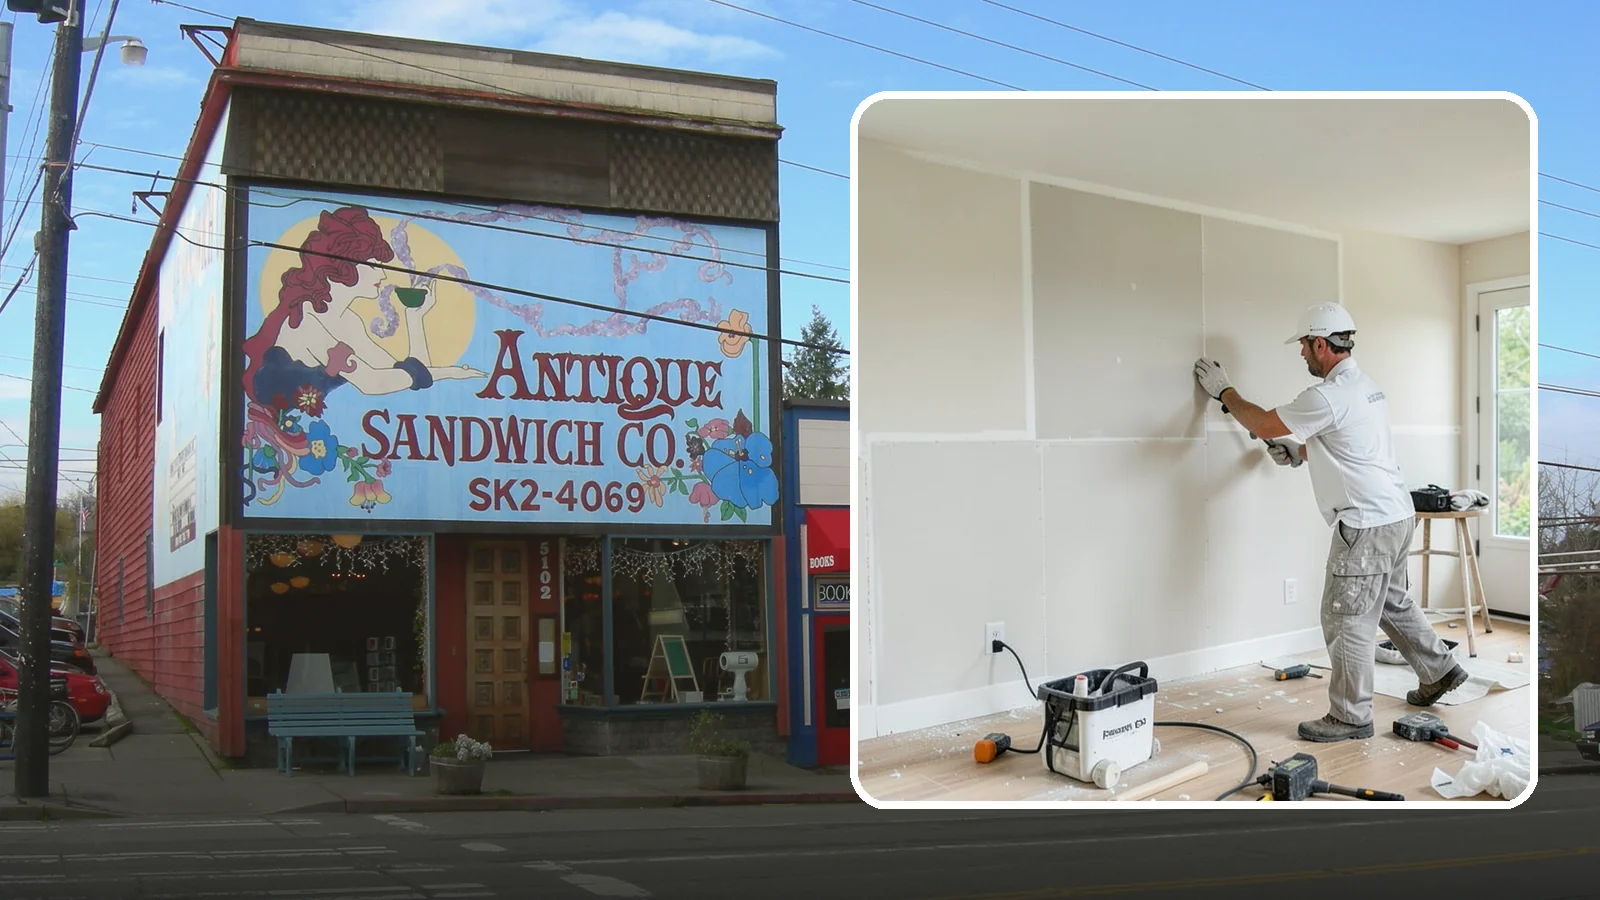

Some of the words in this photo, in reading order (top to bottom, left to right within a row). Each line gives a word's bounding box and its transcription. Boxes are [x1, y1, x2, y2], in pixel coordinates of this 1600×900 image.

[475, 328, 724, 421] ANTIQUE
[361, 408, 605, 467] SANDWICH
[617, 421, 685, 469] CO.
[468, 477, 646, 513] SK2-4069
[540, 541, 552, 600] 5102
[809, 555, 835, 569] BOOKS
